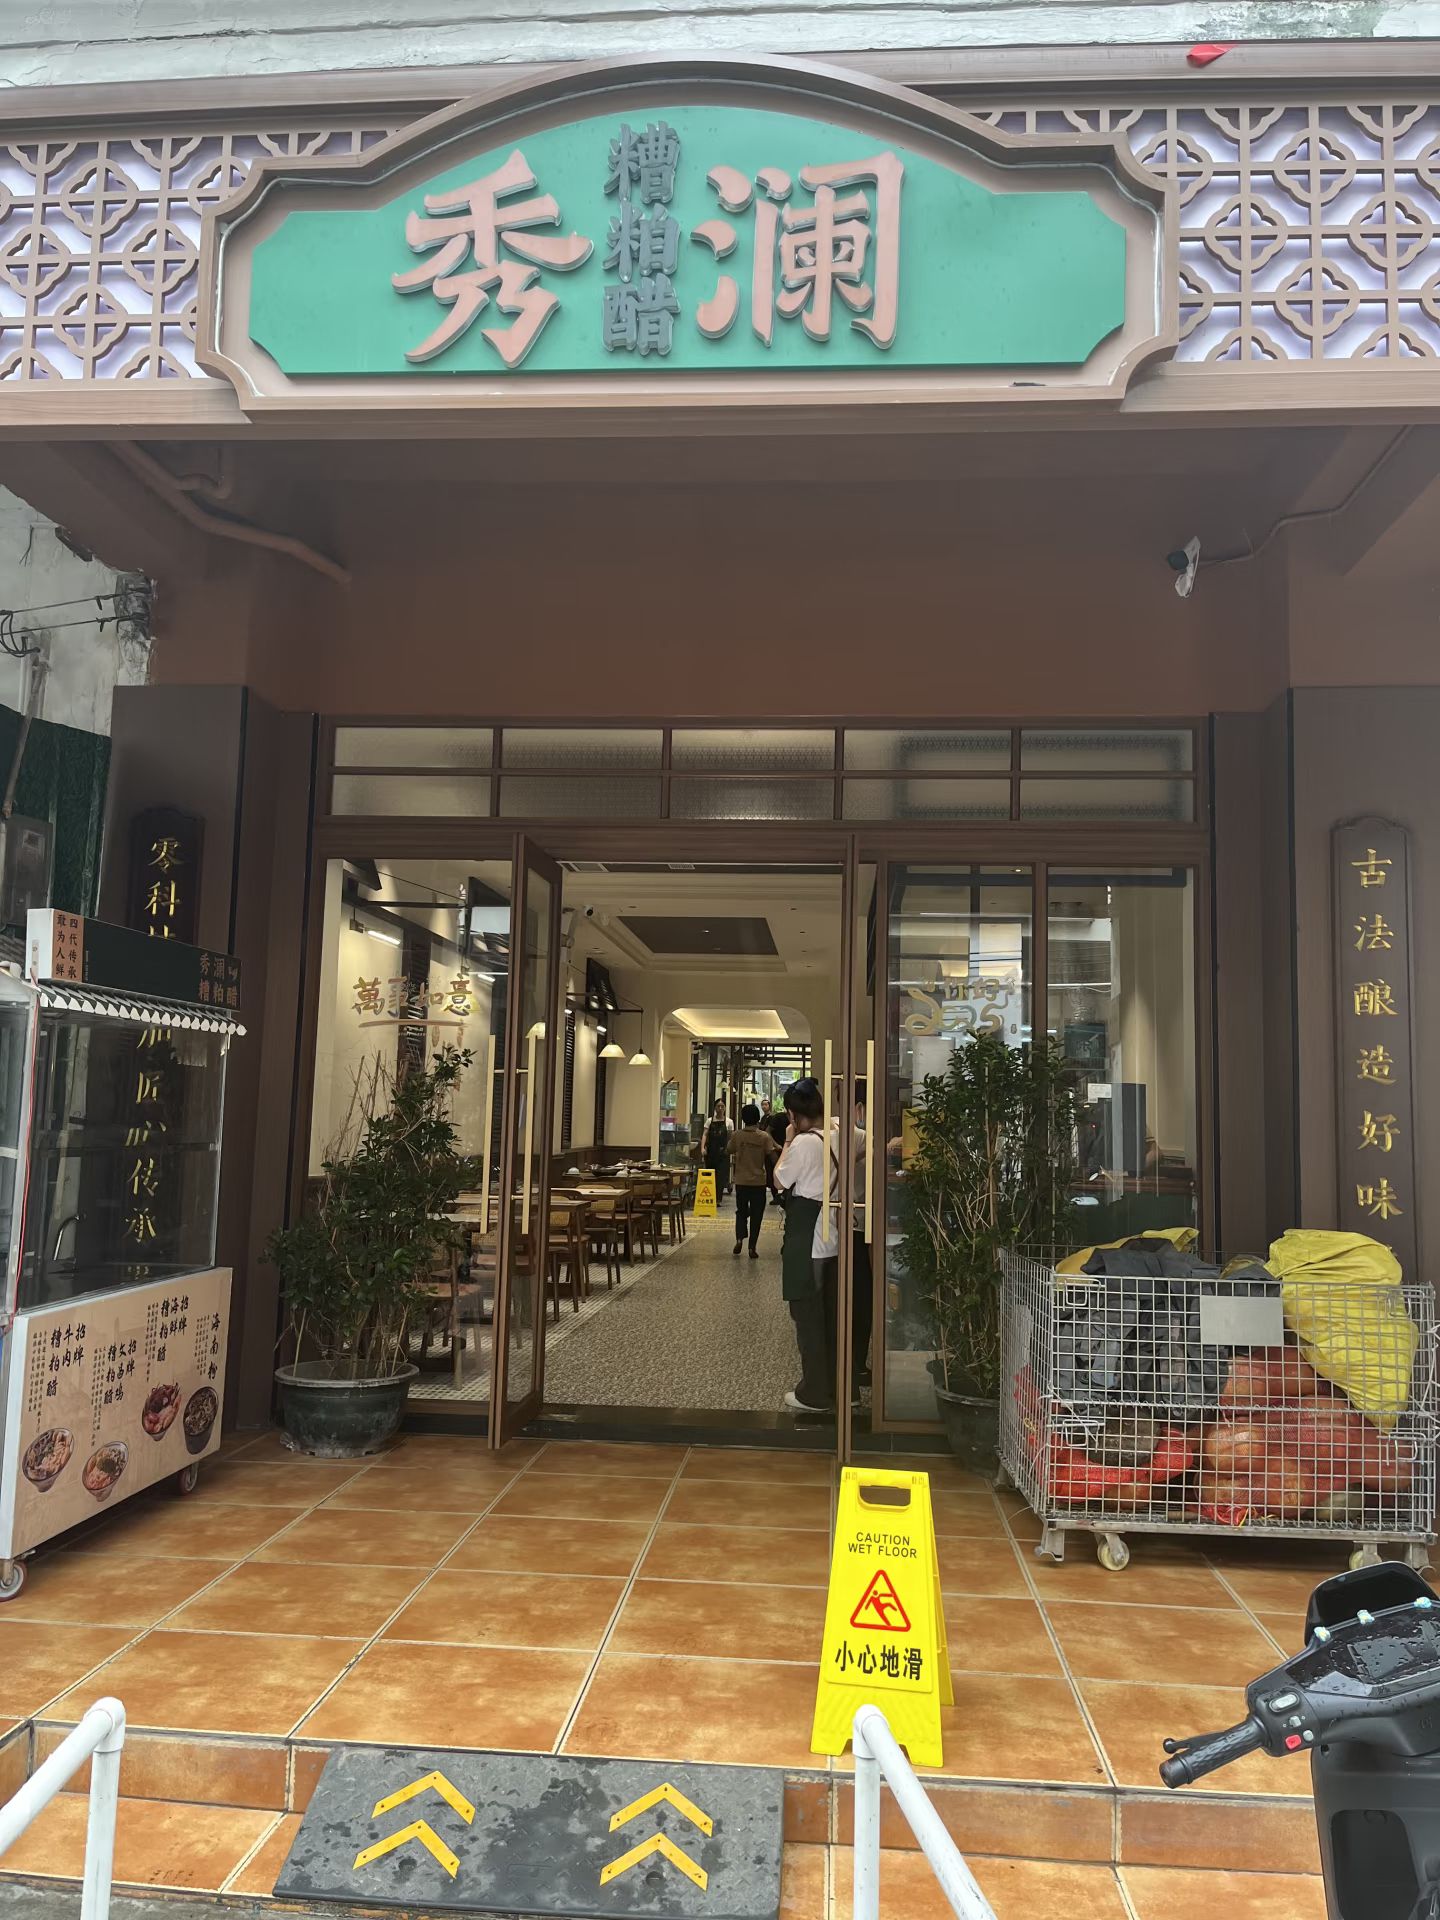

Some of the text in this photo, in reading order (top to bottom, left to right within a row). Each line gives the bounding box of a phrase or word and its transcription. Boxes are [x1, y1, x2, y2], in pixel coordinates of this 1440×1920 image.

[391, 149, 593, 369] 秀
[602, 120, 681, 356] 糟粕醋
[56, 914, 66, 976] 敢为人鲜
[68, 918, 78, 979] 四代传承
[1351, 848, 1404, 1221] 古法酿造好味
[73, 1322, 86, 1367] 招牌
[157, 1298, 170, 1361] 糟粕醋
[179, 1295, 189, 1335] 招牌
[46, 1327, 62, 1396] 糟粕醋
[62, 1324, 73, 1368] 牛肉
[104, 1343, 117, 1404] 糟粕醋
[126, 1339, 137, 1376] 招牌
[208, 1312, 220, 1380] 海南粉
[848, 1543, 917, 1558] WET FLOOR
[856, 1531, 910, 1546] CAUTION
[835, 1640, 923, 1681] 小心地滑
